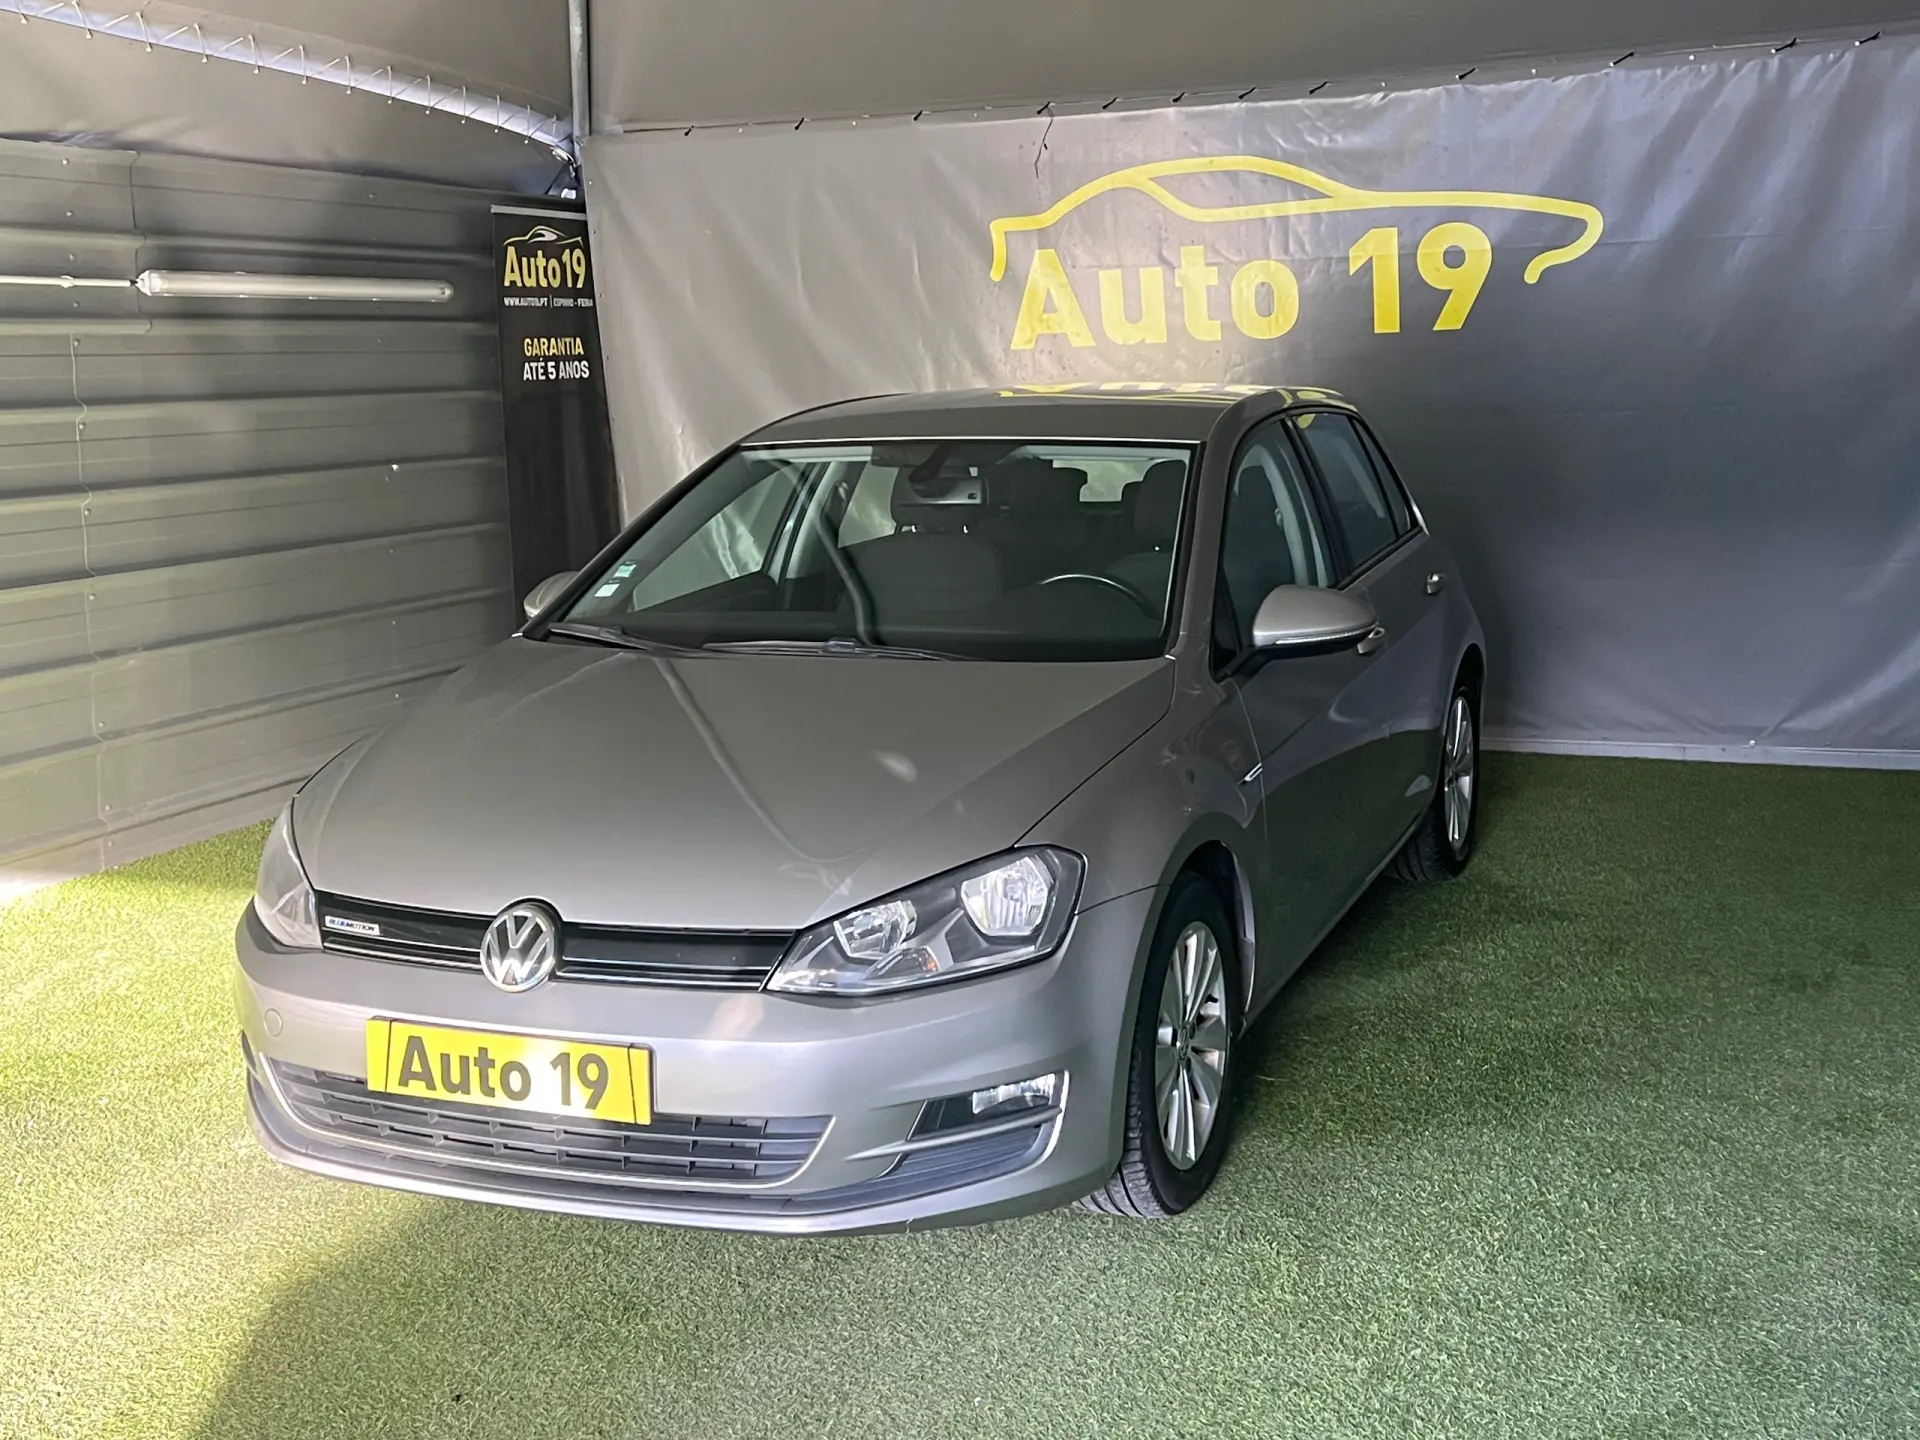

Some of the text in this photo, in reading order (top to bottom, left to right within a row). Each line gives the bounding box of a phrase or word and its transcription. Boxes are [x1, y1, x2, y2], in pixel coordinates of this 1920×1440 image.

[1010, 221, 1493, 350] Auto 19
[523, 337, 584, 357] GARANTIA
[523, 357, 590, 381] ATÉ 5 ANOS
[398, 1035, 609, 1110] Auto 19
